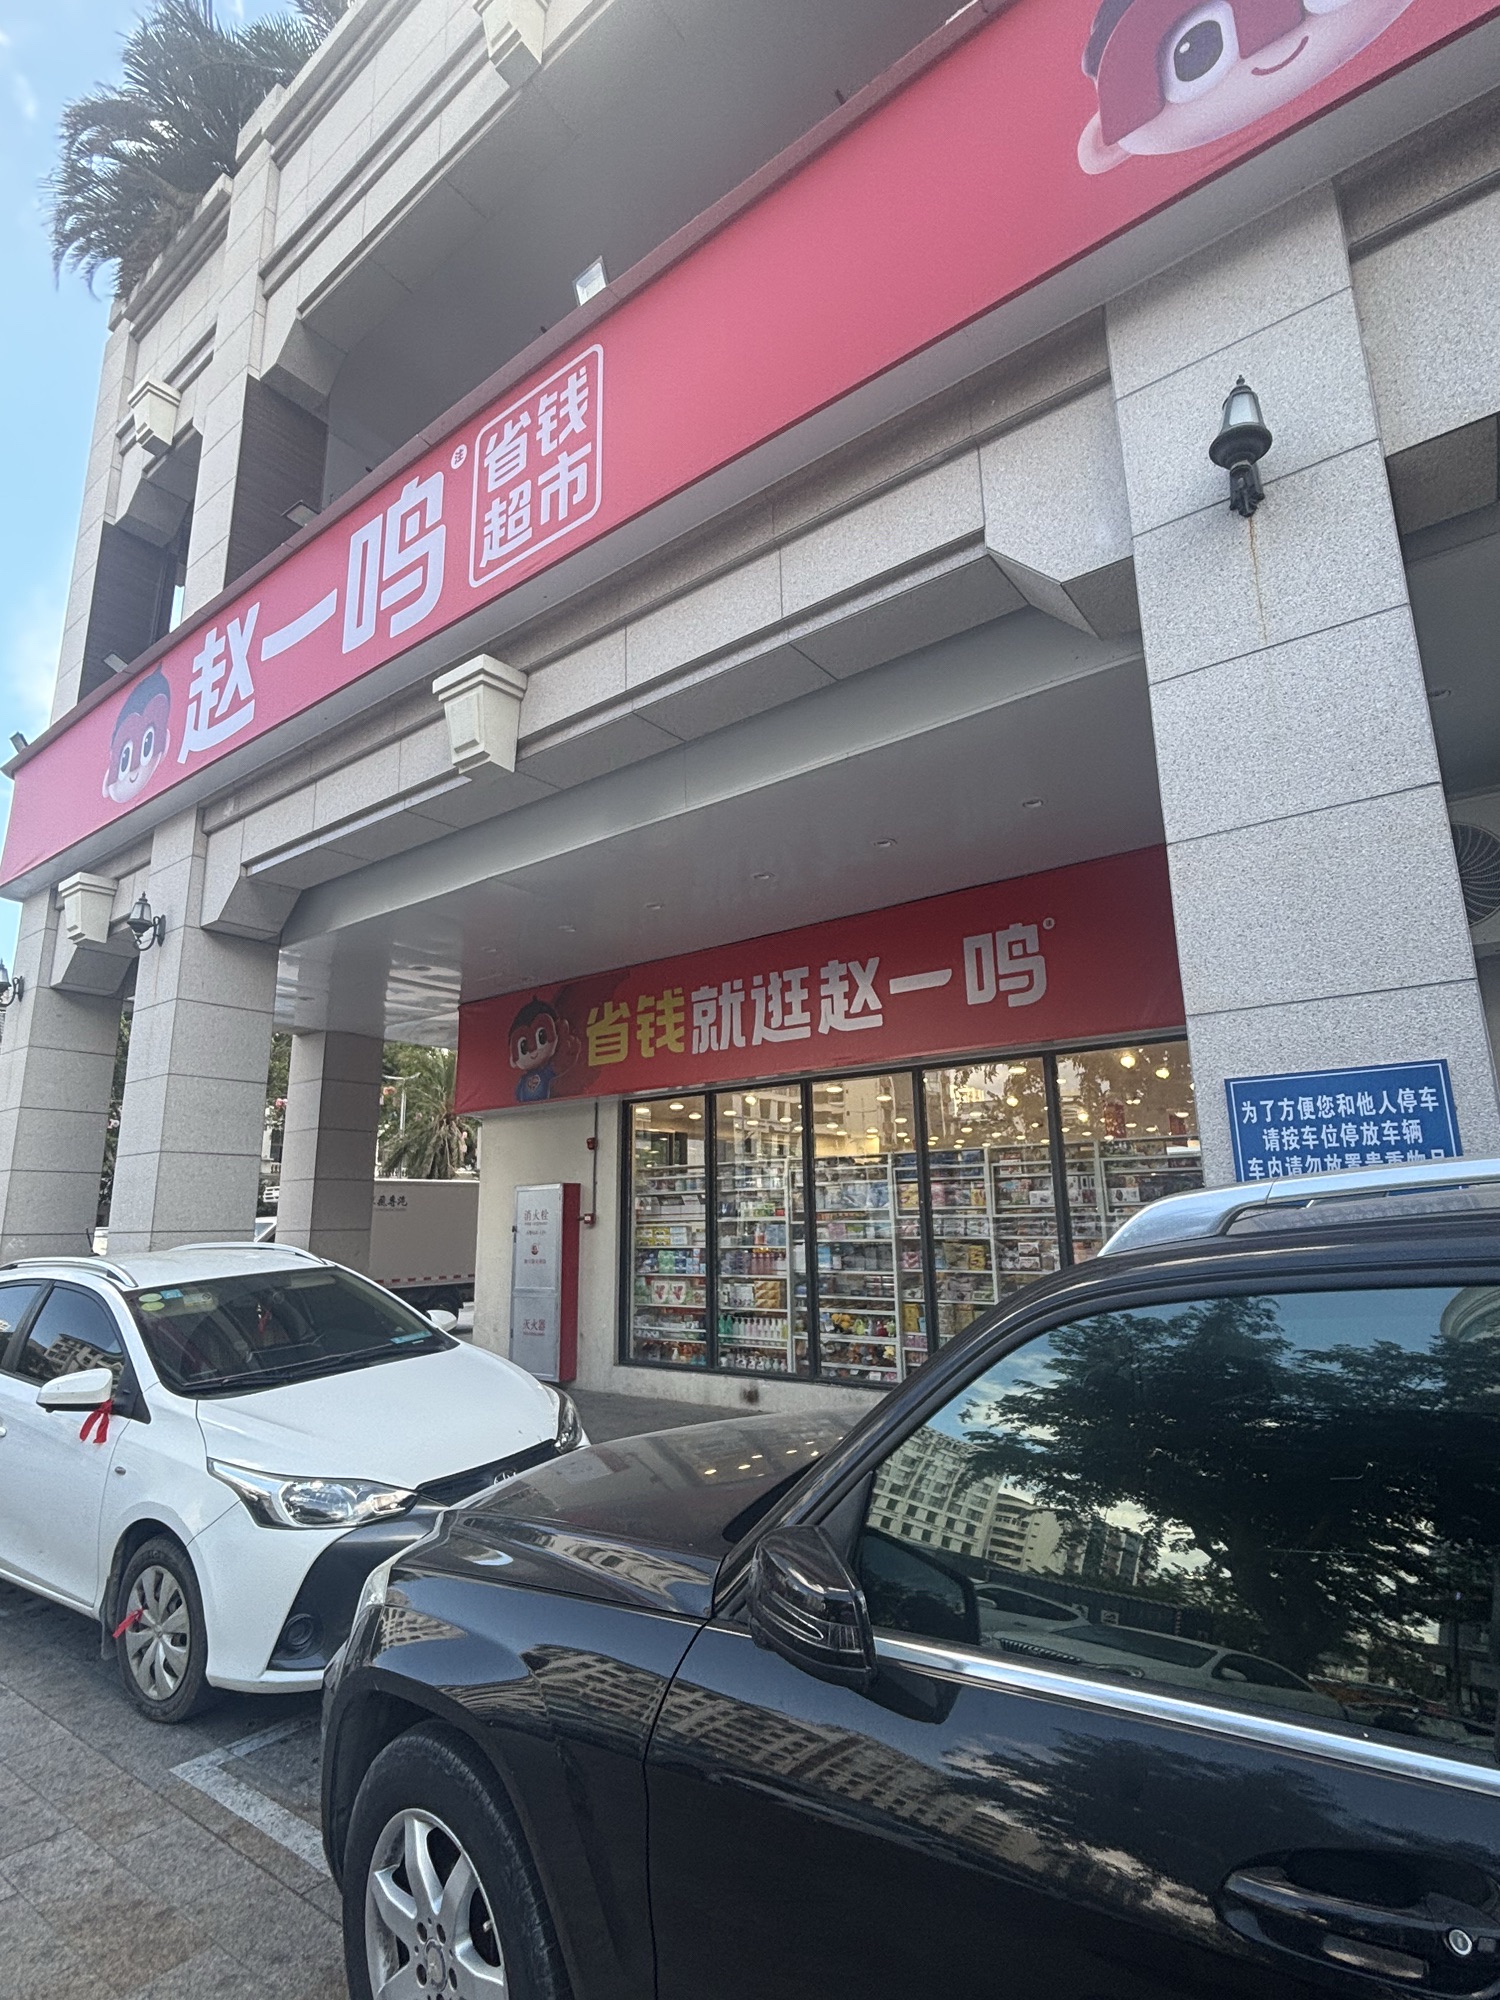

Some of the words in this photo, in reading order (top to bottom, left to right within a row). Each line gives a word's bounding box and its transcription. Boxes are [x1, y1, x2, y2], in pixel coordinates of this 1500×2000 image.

[484, 366, 589, 490] 省钱
[479, 443, 593, 568] 超市
[178, 470, 445, 764] 赵一鸣
[586, 922, 1049, 1067] 省钱就逛赵一鸣
[1241, 1086, 1440, 1125] 为了方便您和他人停车
[1262, 1118, 1423, 1152] 请按车位停放车辆
[524, 1209, 549, 1221] 消火栓
[523, 1318, 546, 1331] 灭火器
